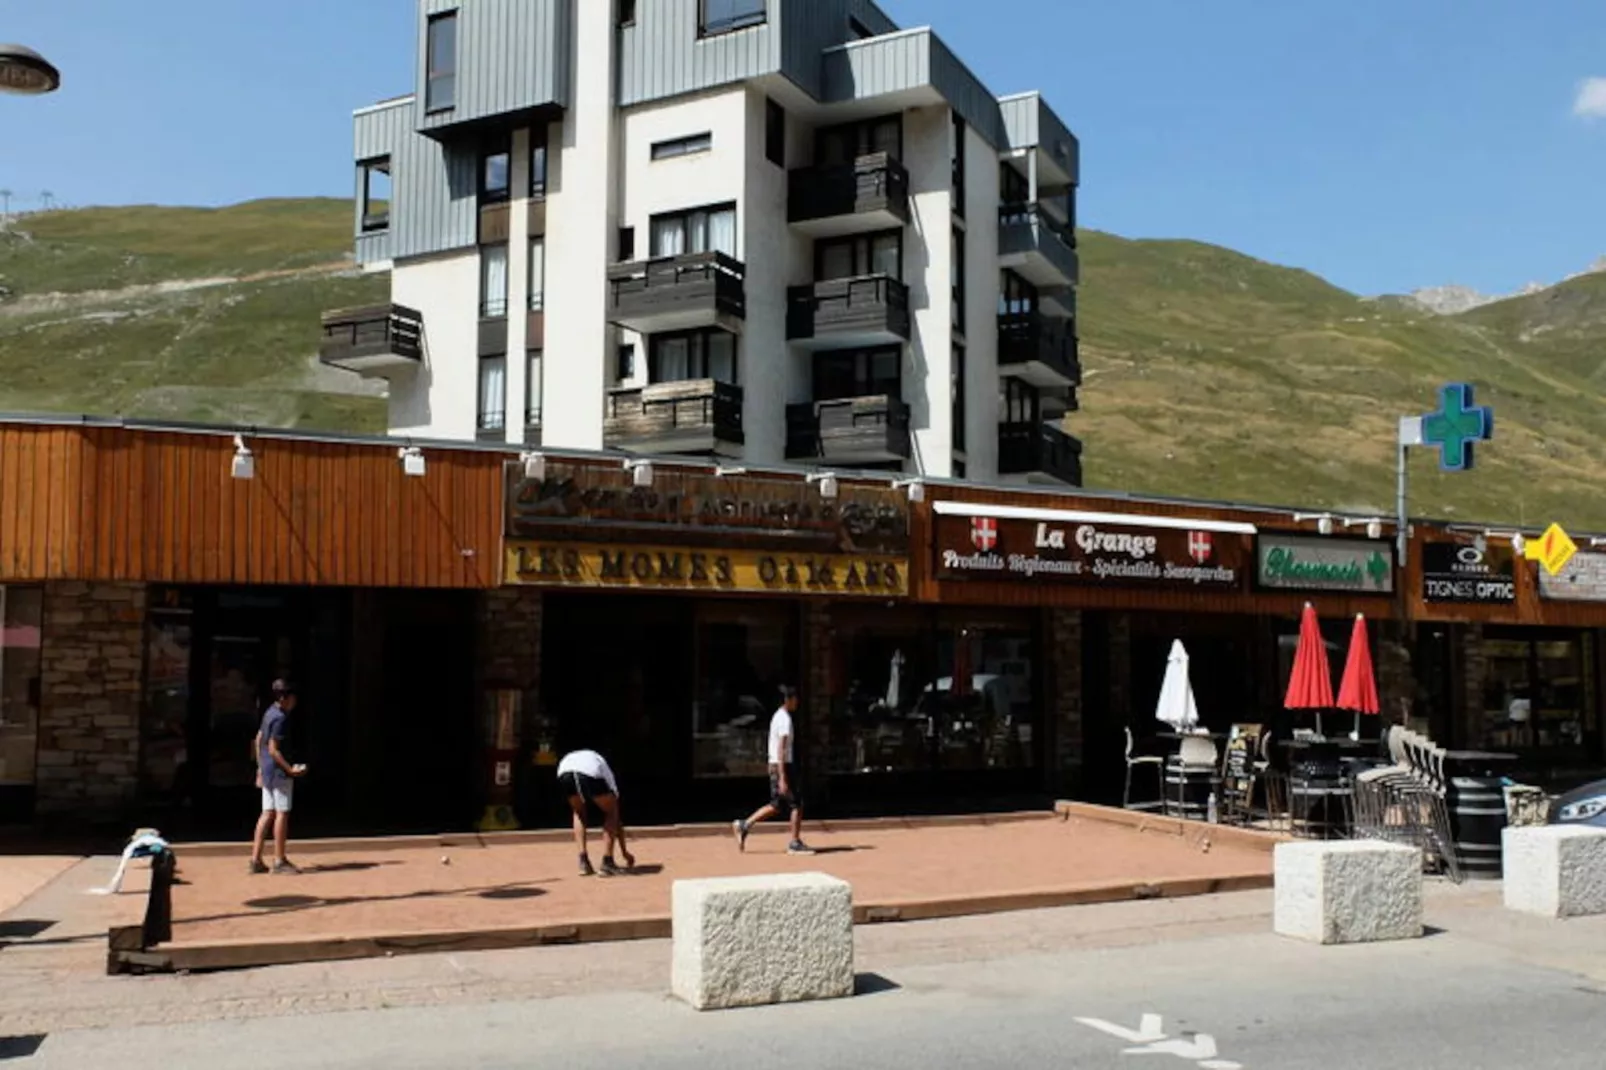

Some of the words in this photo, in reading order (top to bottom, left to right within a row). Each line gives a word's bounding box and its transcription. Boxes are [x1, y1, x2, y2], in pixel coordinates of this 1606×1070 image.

[1035, 522, 1065, 549] La
[1075, 525, 1157, 559] Grange
[515, 547, 580, 576] LES
[599, 549, 734, 582] MOMES
[943, 549, 1004, 570] Produits
[1425, 580, 1474, 597] TIGNES
[1476, 581, 1515, 599] OPTIC
